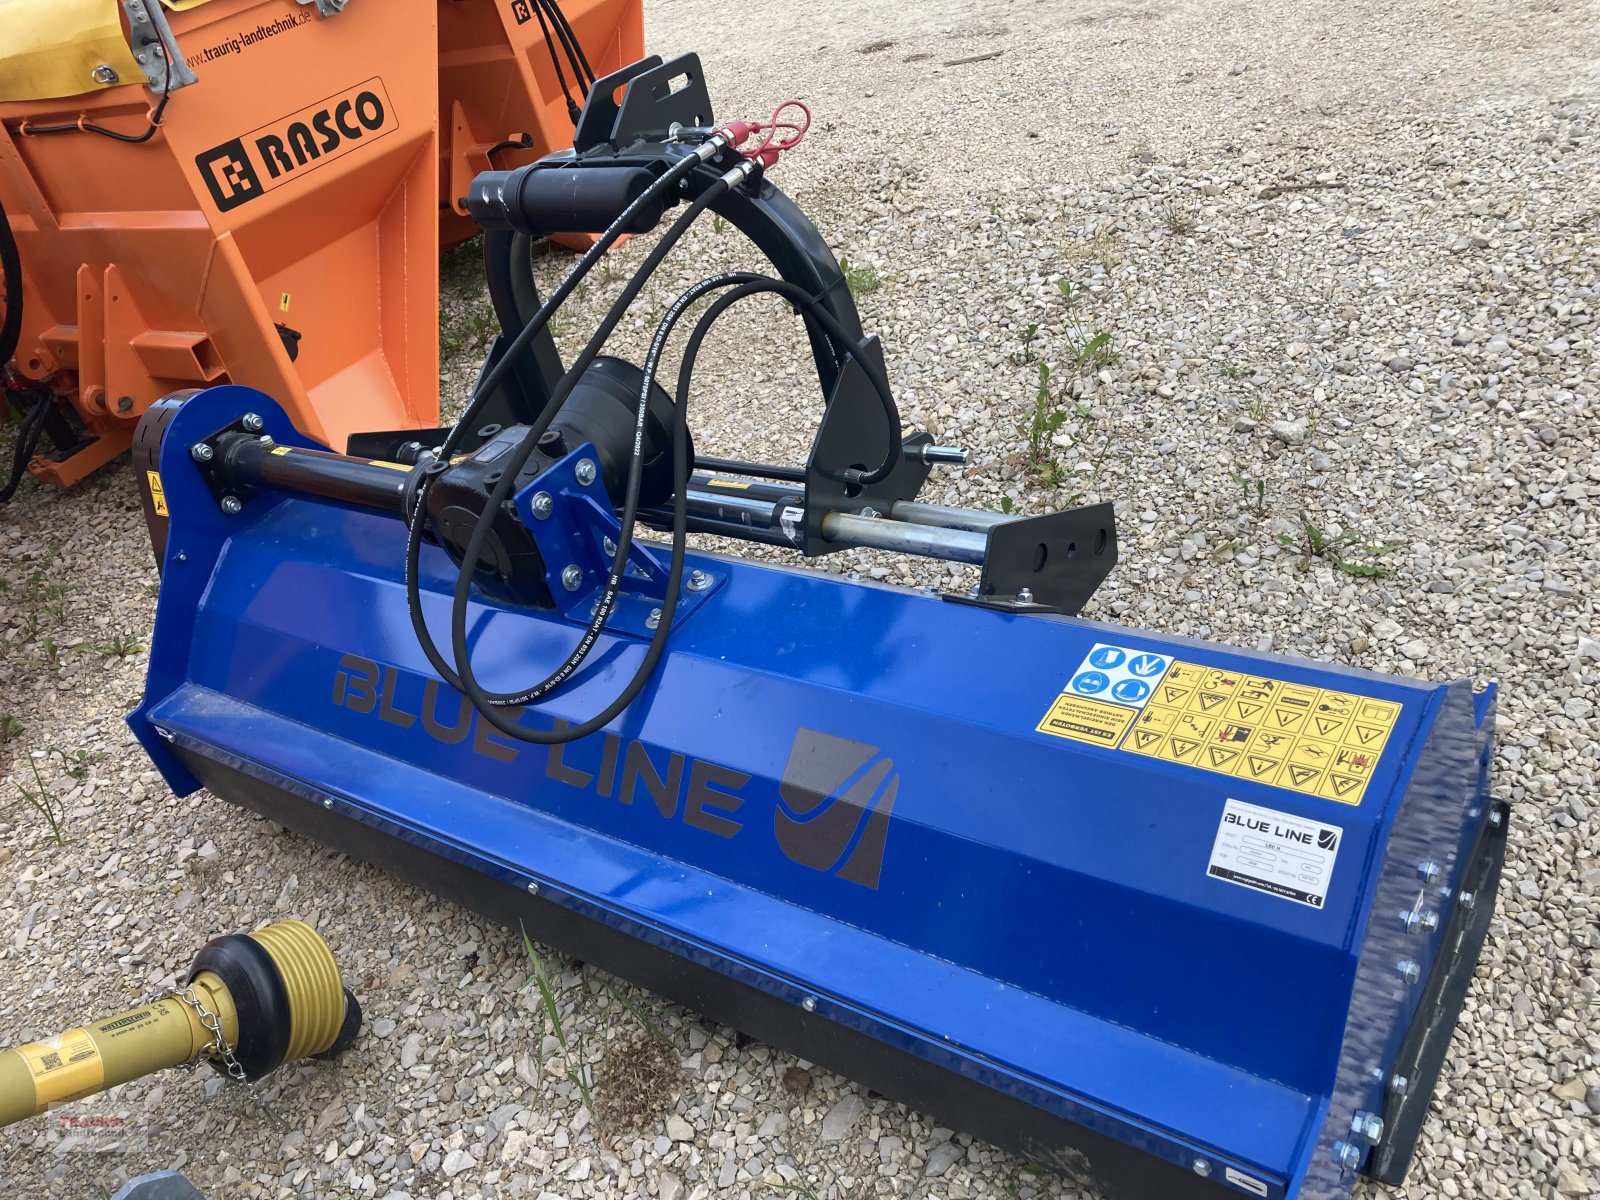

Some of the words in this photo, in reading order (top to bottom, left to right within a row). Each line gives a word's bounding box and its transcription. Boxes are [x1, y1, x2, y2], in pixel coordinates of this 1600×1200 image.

[186, 9, 312, 69] ww.traurig-landtechnik.de
[255, 91, 385, 179] RASCO
[689, 284, 702, 296] R2AT
[680, 295, 688, 304] EN
[660, 322, 669, 331] DN
[640, 375, 650, 399] 5075PSI
[637, 403, 645, 427] 350BAR
[633, 431, 642, 456] Q4/2022
[604, 590, 613, 604] SAE
[599, 605, 608, 616] 100
[592, 616, 603, 633] R2AT
[585, 635, 593, 645] EN
[570, 653, 581, 666] 2SN
[563, 665, 572, 674] DN
[1052, 720, 1088, 733] VERBOTEN
[1089, 727, 1101, 735] IST
[331, 653, 526, 764] BLUE
[545, 717, 752, 839] LINE
[1224, 813, 1271, 833] BLUE
[1274, 826, 1314, 844] LINE
[99, 1011, 151, 1033] WALTERSCHEID
